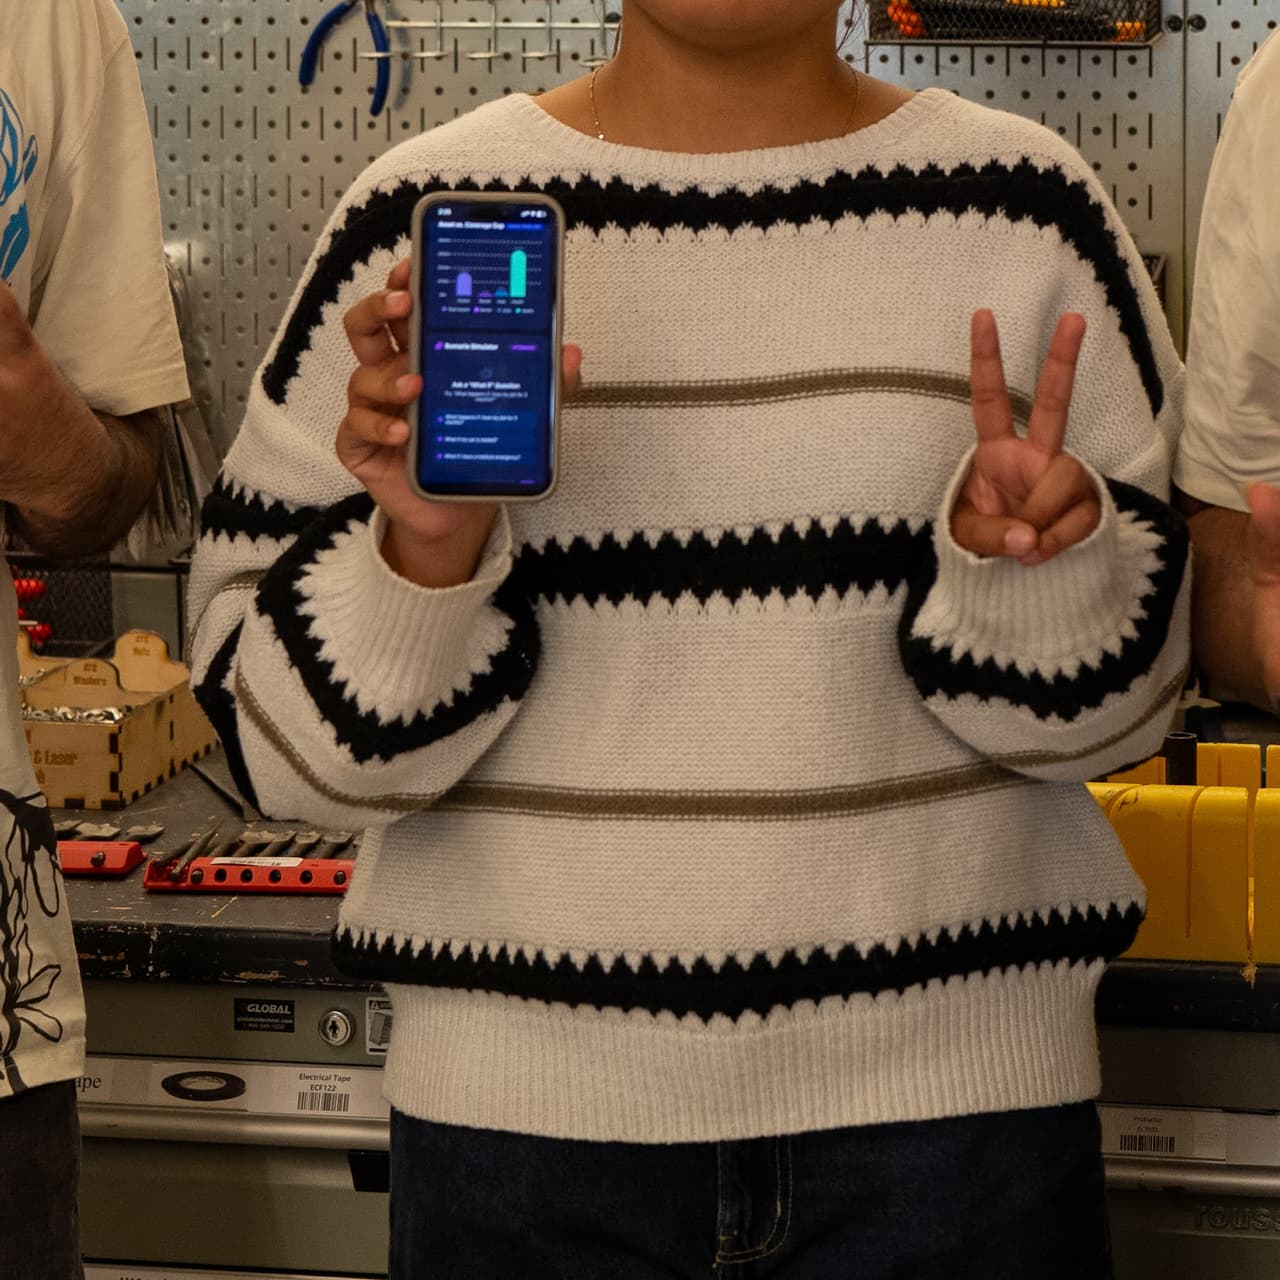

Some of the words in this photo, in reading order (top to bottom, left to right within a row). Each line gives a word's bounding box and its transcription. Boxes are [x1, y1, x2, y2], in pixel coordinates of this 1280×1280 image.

[247, 1003, 292, 1015] GLOBAL
[76, 1073, 102, 1091] ape
[299, 1073, 332, 1082] Electrical
[333, 1074, 351, 1083] Tape
[310, 1084, 337, 1092] ECF122
